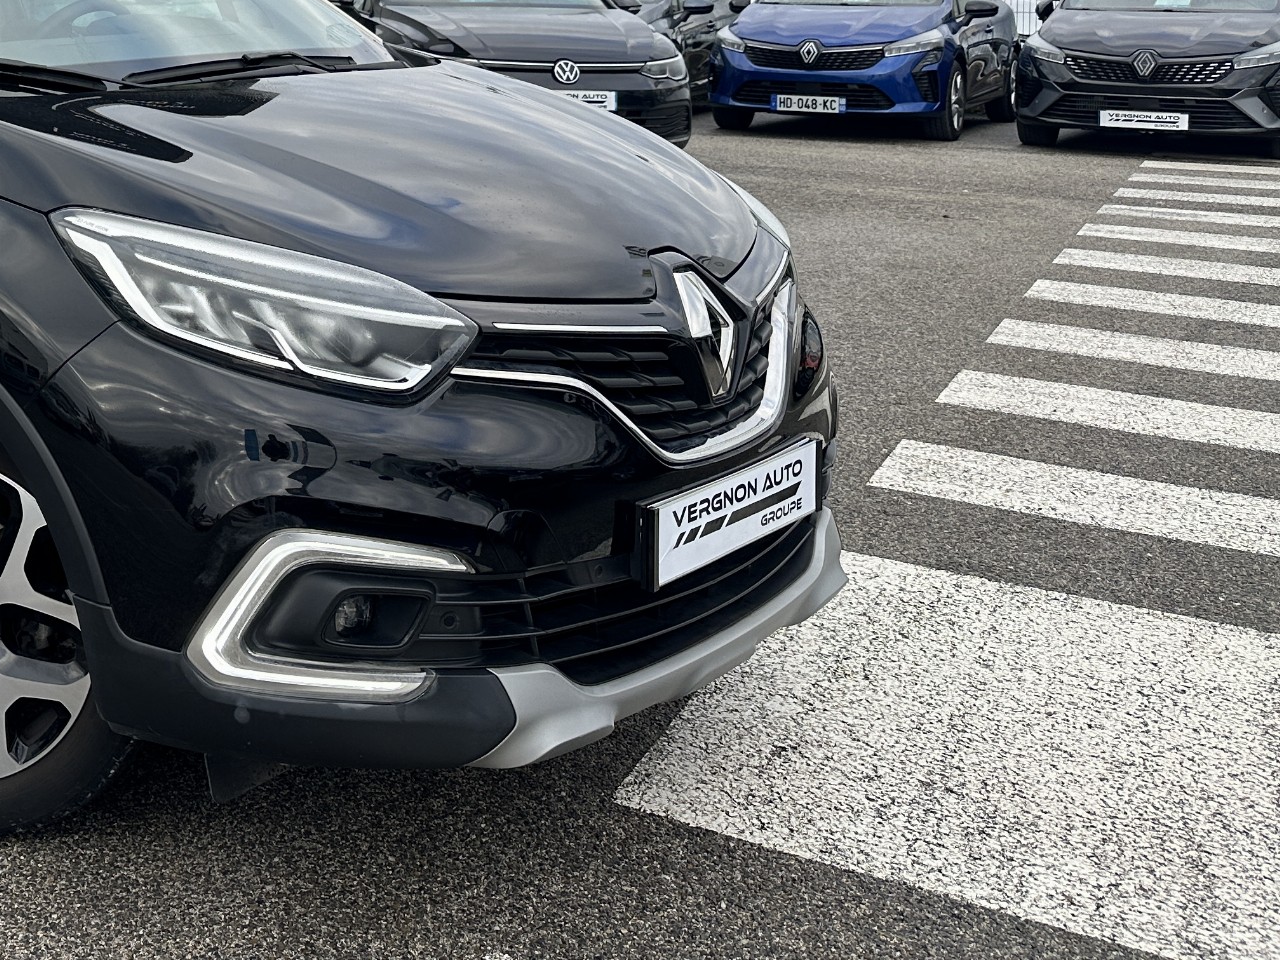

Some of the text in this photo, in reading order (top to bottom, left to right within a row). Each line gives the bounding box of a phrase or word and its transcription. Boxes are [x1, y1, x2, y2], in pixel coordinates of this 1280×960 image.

[778, 96, 837, 111] HD-048-KC
[1108, 112, 1152, 120] VERGNON
[672, 458, 803, 528] VERGNON AUTO
[760, 497, 803, 527] GROUPE
